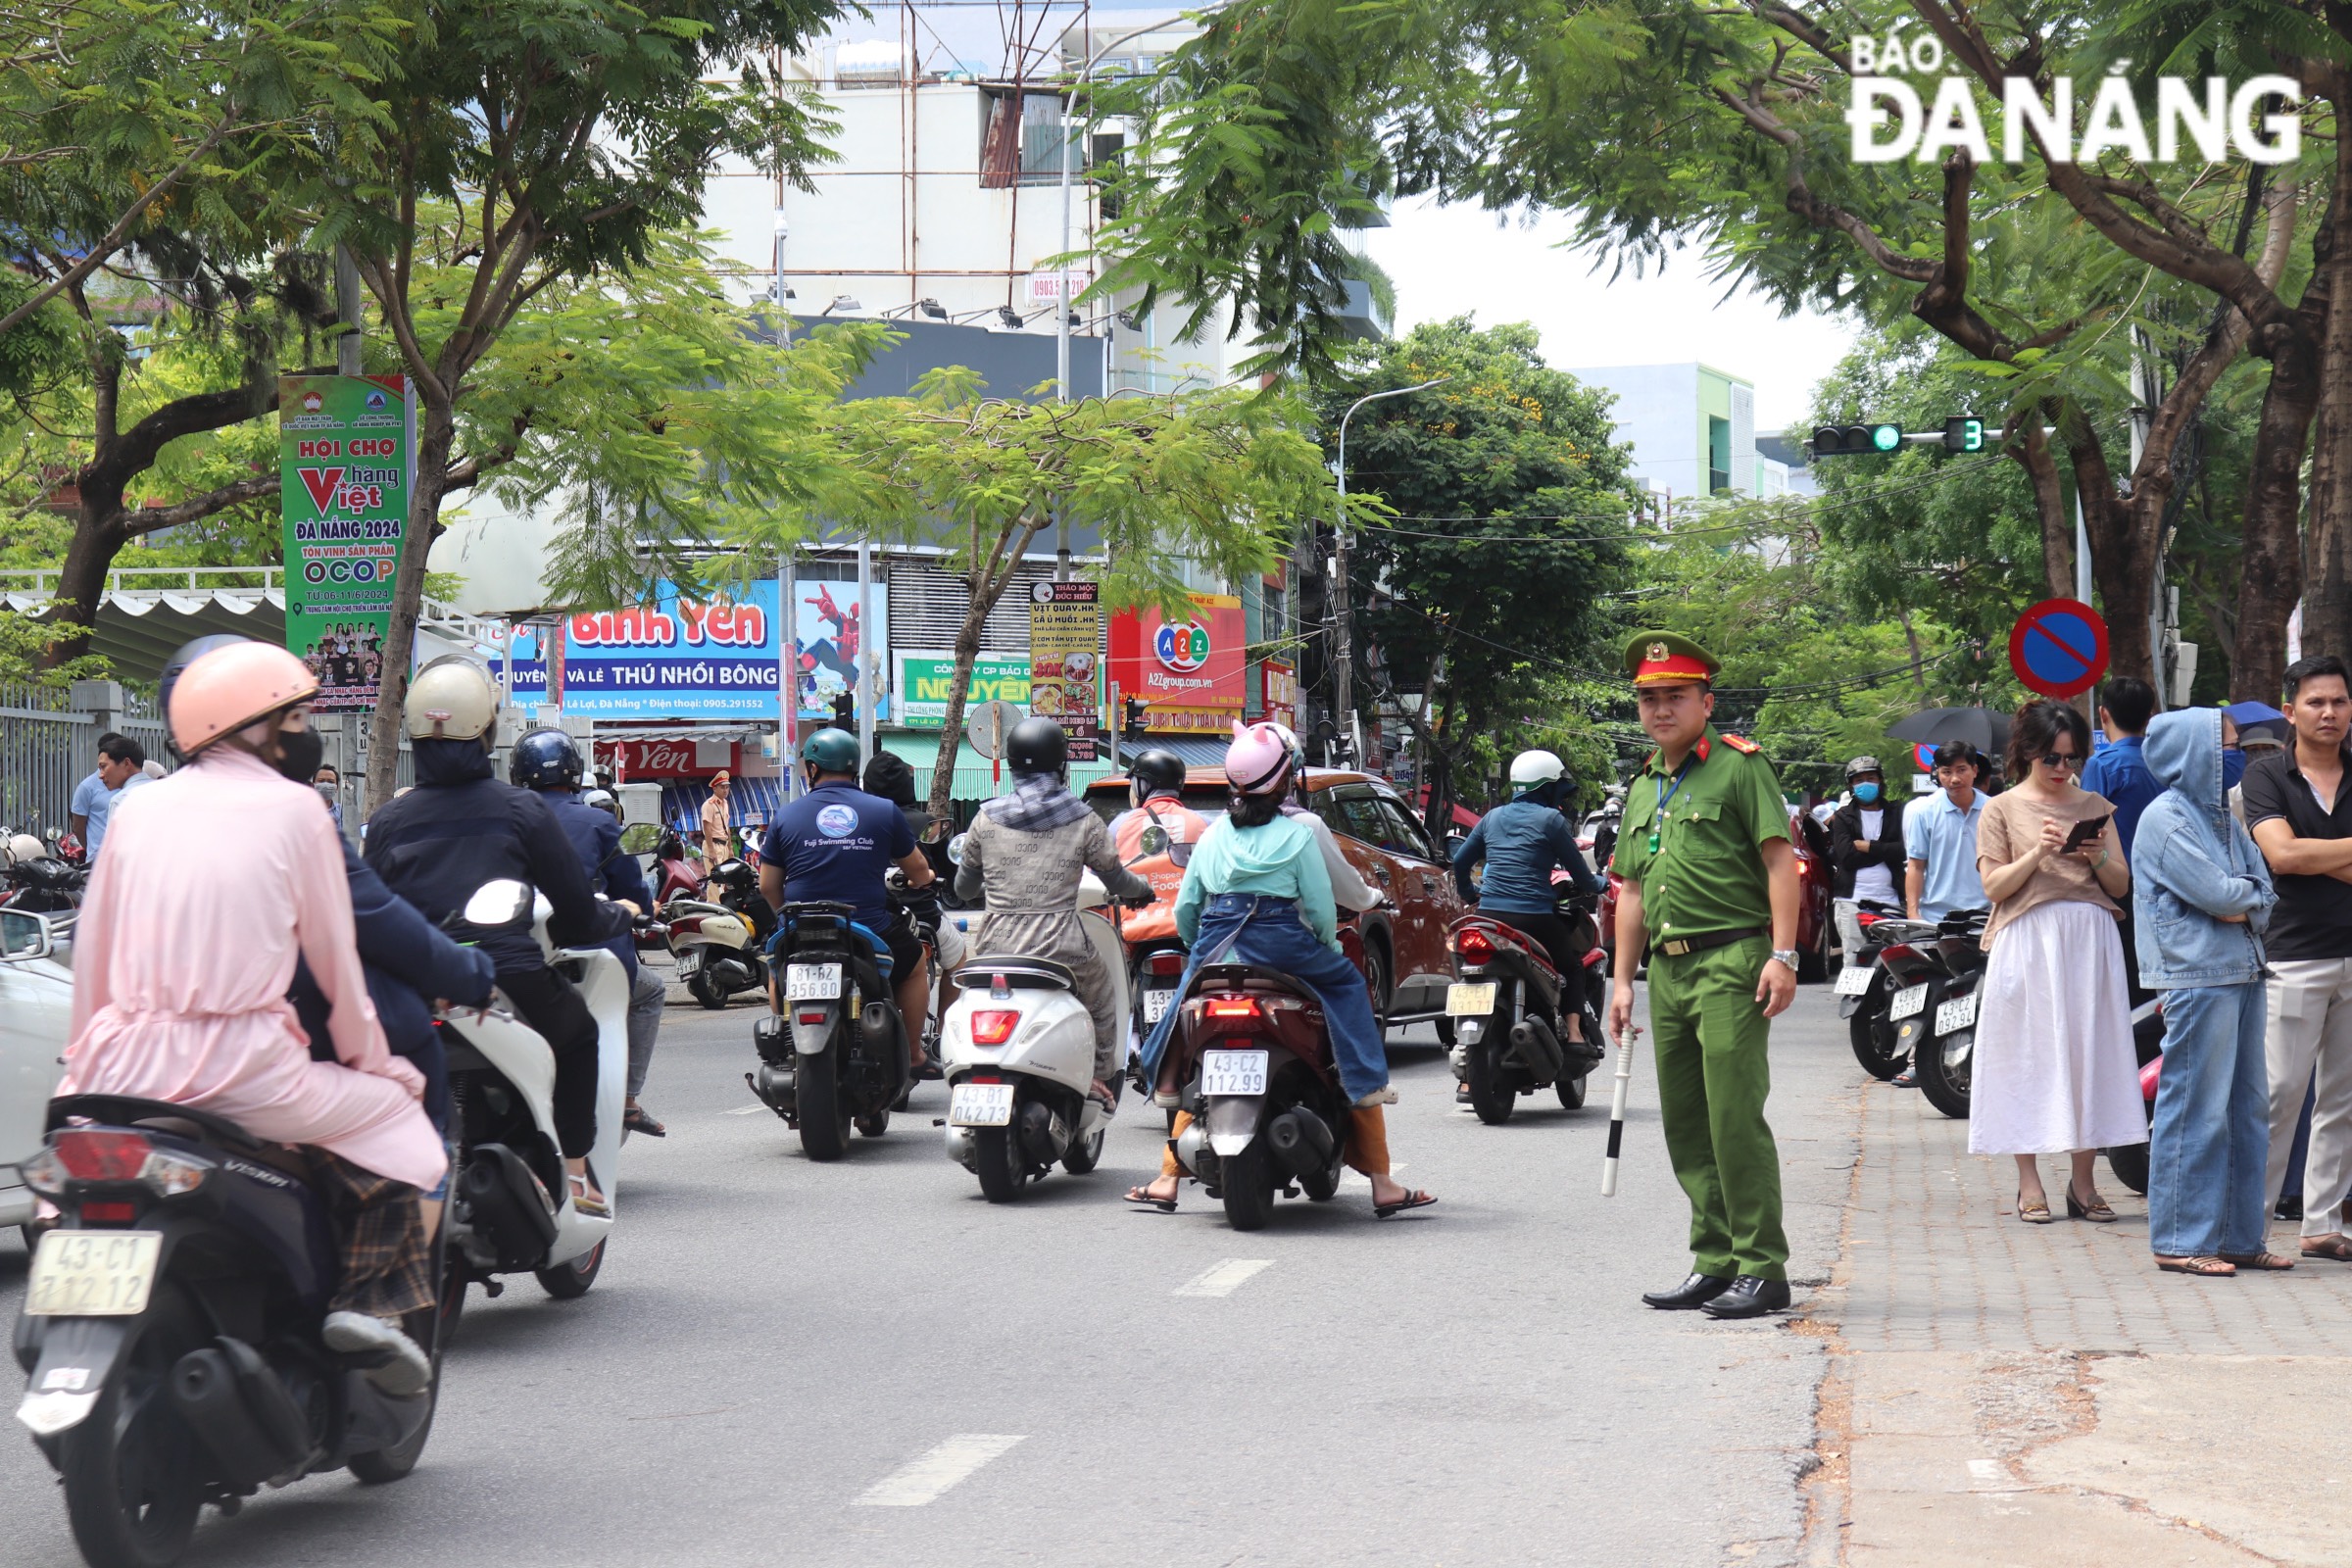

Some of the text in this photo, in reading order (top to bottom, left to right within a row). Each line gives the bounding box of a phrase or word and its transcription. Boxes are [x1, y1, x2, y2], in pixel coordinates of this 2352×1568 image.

[1965, 420, 1982, 450] 3
[299, 437, 396, 462] HỘI CHỢ
[351, 465, 399, 488] hàng
[297, 467, 382, 517] Việt
[296, 515, 401, 539] ĐÀ NẴNG 2024
[303, 542, 395, 558] TÔN VINH SẢN PHẨM
[304, 559, 394, 584] OCOP
[677, 594, 769, 648] Yên
[1054, 613, 1078, 623] MUỐI
[567, 668, 585, 682] VÀ
[589, 667, 604, 683] LẺ
[612, 662, 657, 684] THÚ
[661, 661, 713, 684] NHỒI
[719, 663, 777, 685] BÔNG
[1000, 664, 1021, 674] BẢO
[1034, 662, 1064, 678] 30K
[1149, 672, 1212, 690] A2Zgroup.com.vn
[567, 699, 579, 709] Lê
[599, 698, 613, 710] Đà
[614, 698, 640, 710] Nẵng
[649, 699, 671, 710] Điện
[673, 699, 702, 710] thoại:
[703, 699, 763, 710] 0905.291552
[639, 743, 690, 772] Yên
[817, 838, 856, 847] Swimming
[1151, 872, 1181, 881] Shopee
[1151, 880, 1182, 891] Food
[791, 982, 837, 998] 356.80
[1455, 986, 1488, 1000] 43-E1
[1942, 998, 1970, 1017] 43-C2
[1938, 1012, 1972, 1033] 092.94
[1213, 1054, 1258, 1072] 43-C2
[1207, 1074, 1262, 1092] 112.99
[962, 1088, 1003, 1103] 43-B1
[955, 1105, 1006, 1122] 042.73
